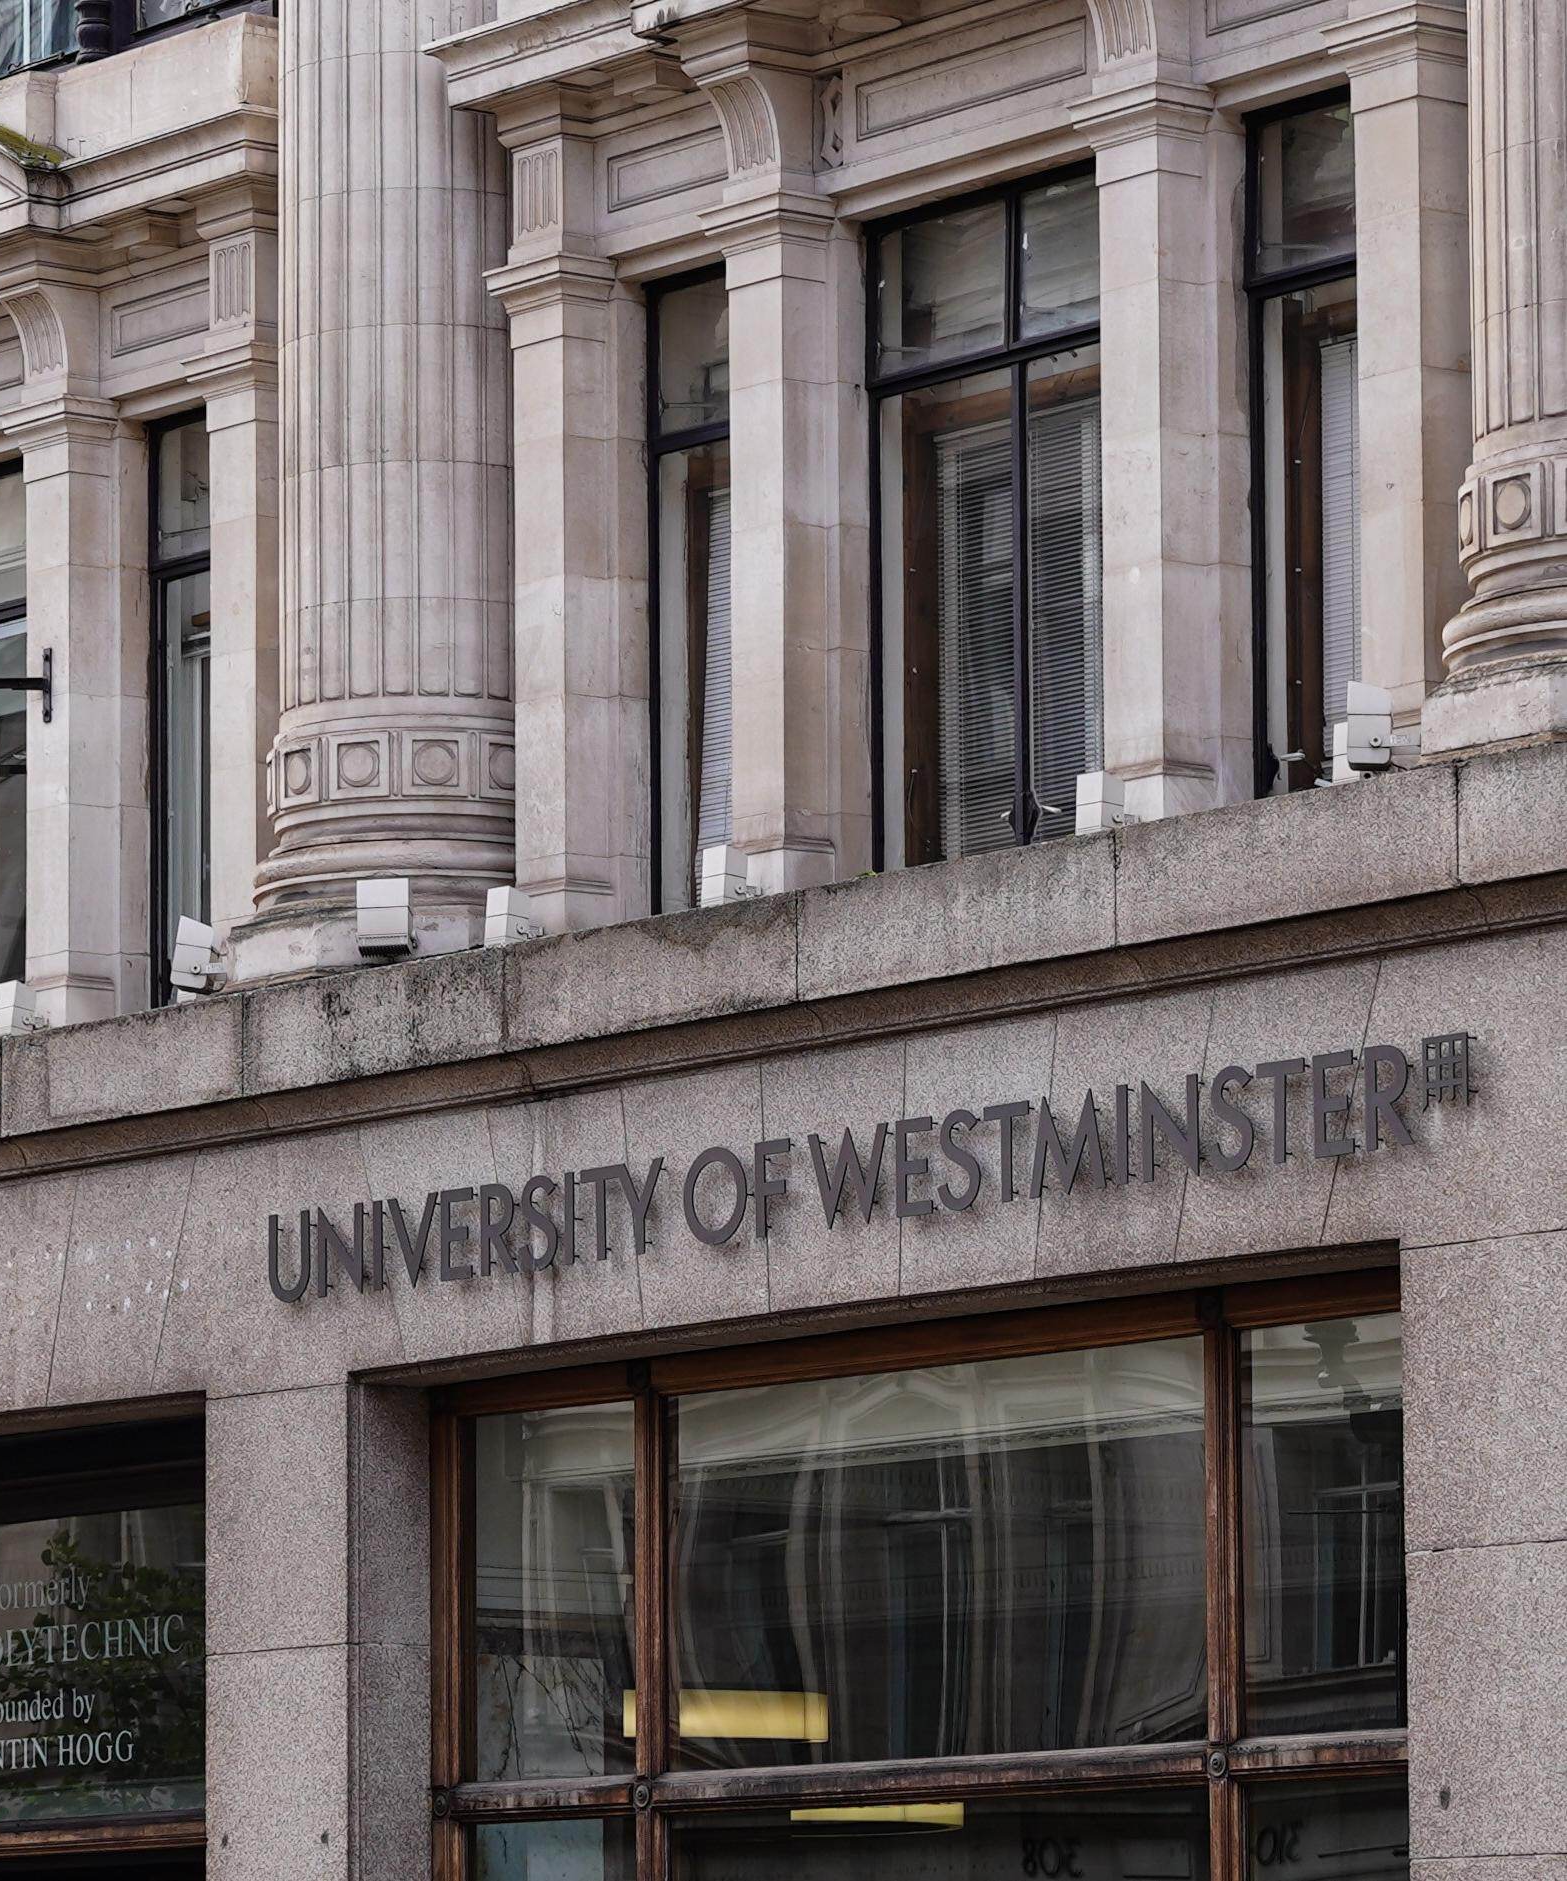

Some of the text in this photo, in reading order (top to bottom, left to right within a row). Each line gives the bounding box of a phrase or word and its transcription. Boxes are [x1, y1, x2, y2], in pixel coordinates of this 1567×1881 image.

[267, 1043, 1416, 1303] UNIVERSITY OF WESTMINSTER
[72, 1687, 96, 1724] by
[58, 1730, 135, 1767] HOGG
